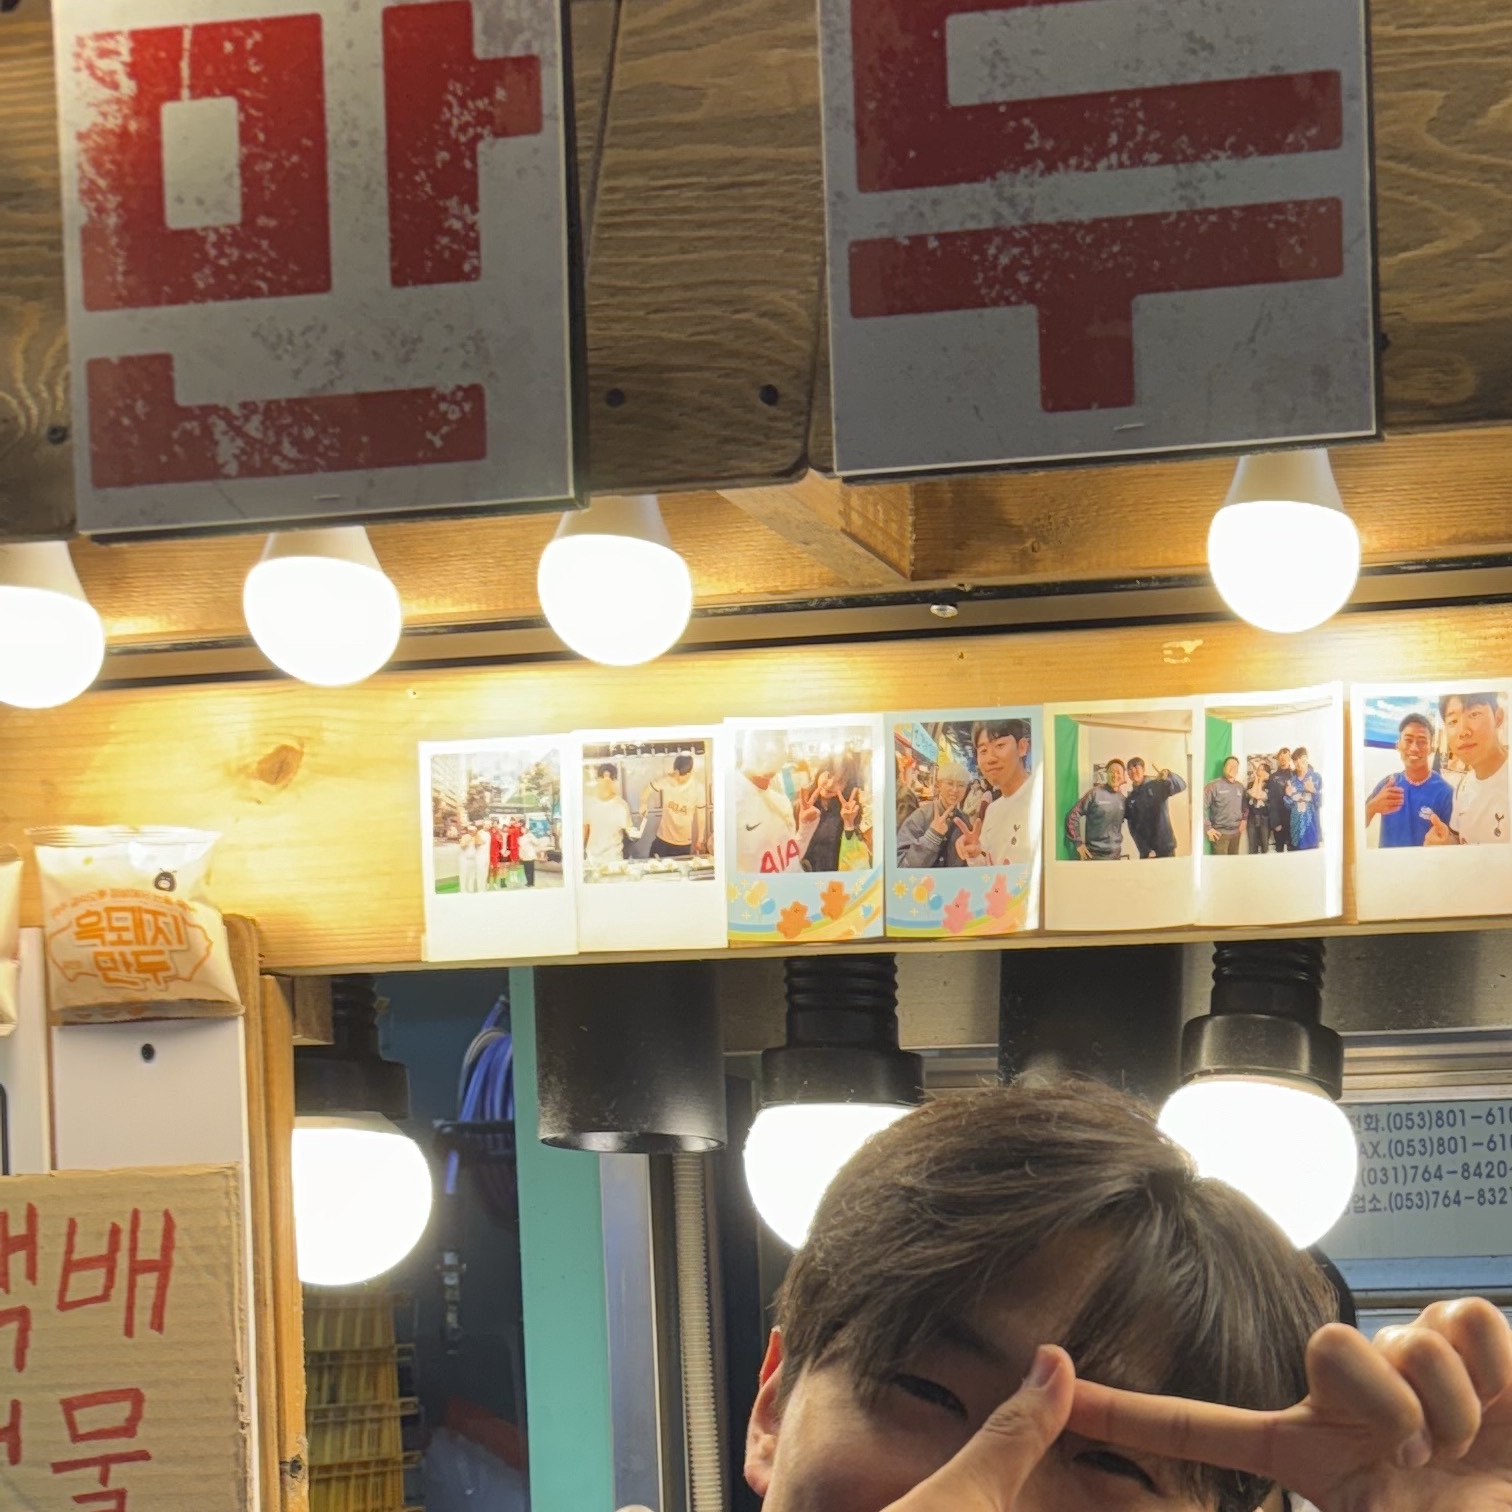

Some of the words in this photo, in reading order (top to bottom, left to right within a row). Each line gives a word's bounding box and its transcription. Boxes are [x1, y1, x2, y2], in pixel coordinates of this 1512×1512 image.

[760, 839, 799, 873] AIA
[74, 906, 183, 947] 흑돼지
[94, 950, 172, 986] 만두
